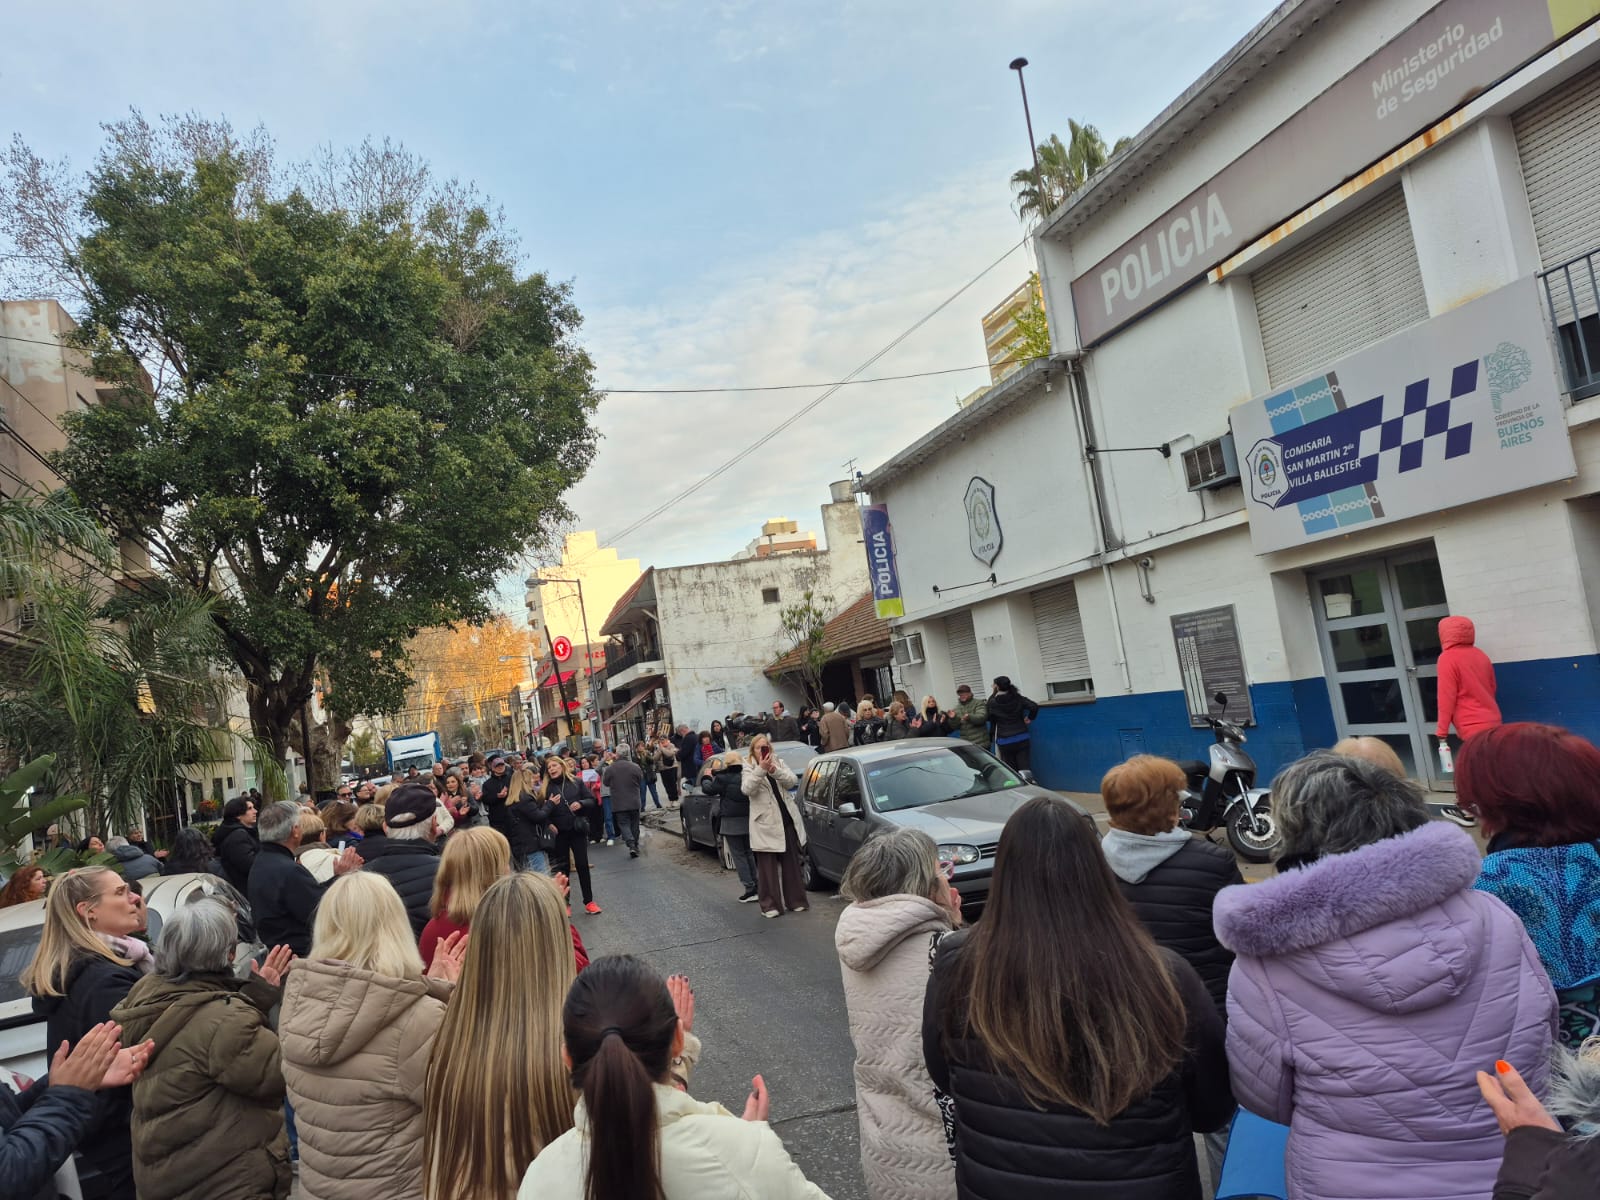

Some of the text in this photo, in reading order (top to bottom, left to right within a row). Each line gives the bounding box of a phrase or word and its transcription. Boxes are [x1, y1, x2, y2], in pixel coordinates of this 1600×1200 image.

[1372, 23, 1464, 99] Ministerio
[1376, 17, 1503, 120] de Seguridad
[1101, 192, 1232, 316] POLICIA
[1497, 416, 1544, 438] BUENOS
[1500, 432, 1532, 449] AIRES
[1284, 435, 1332, 459] COMISARIA
[1286, 460, 1303, 474] SAN
[1305, 449, 1341, 467] MARTIN
[1289, 458, 1362, 488] VILLA BALLESTER
[1260, 489, 1281, 499] POLICIA
[873, 531, 893, 595] POLICIA
